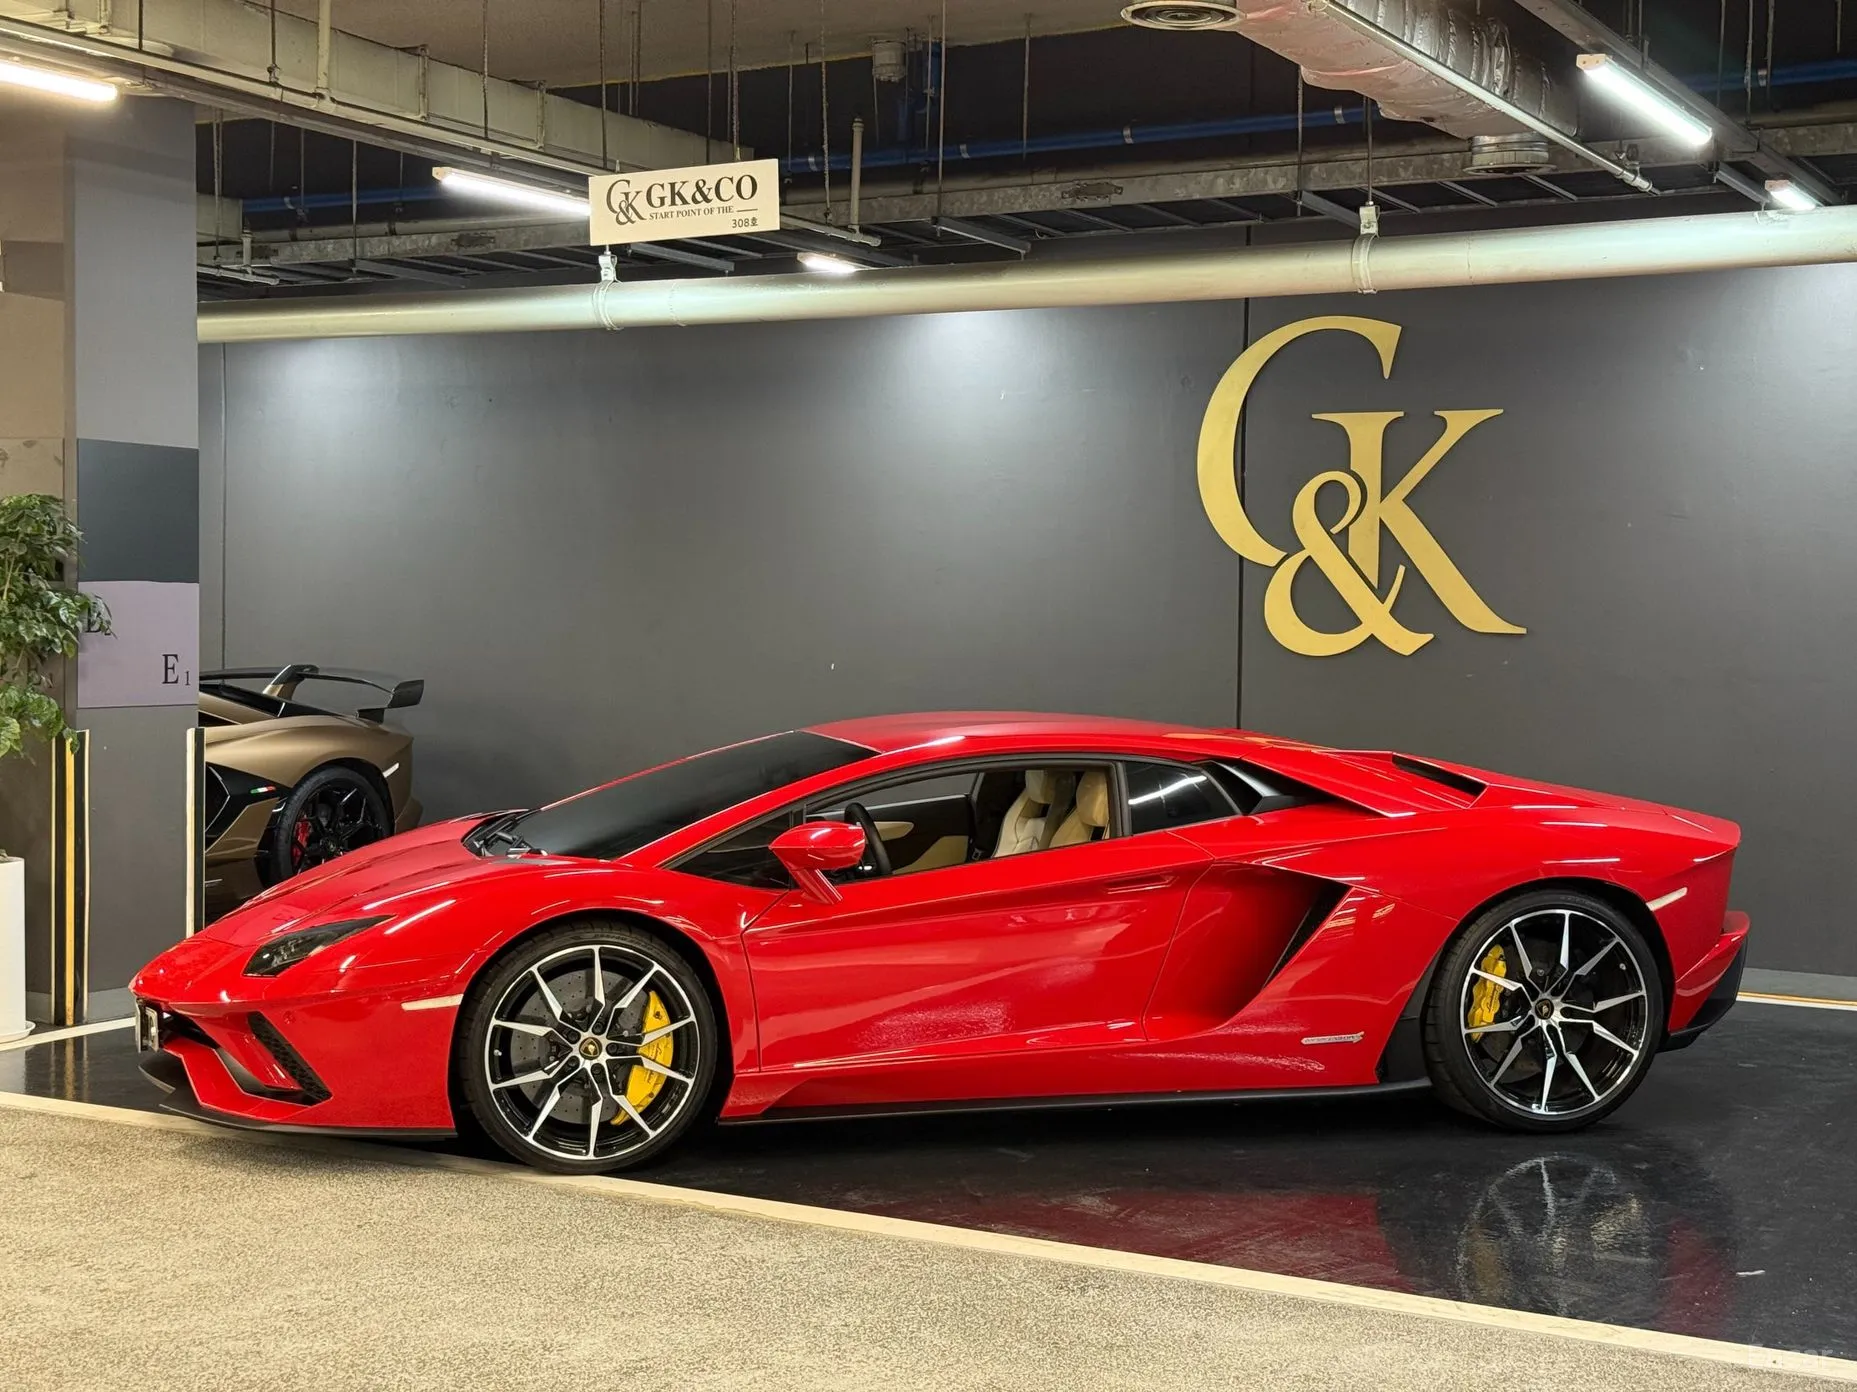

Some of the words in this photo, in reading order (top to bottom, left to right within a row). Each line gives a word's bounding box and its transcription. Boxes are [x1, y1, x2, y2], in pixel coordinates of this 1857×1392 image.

[646, 174, 758, 209] GK&CO
[649, 211, 674, 220] START
[676, 208, 701, 217] POINT
[703, 207, 715, 216] OF
[717, 205, 734, 214] THE
[161, 653, 191, 686] E1
